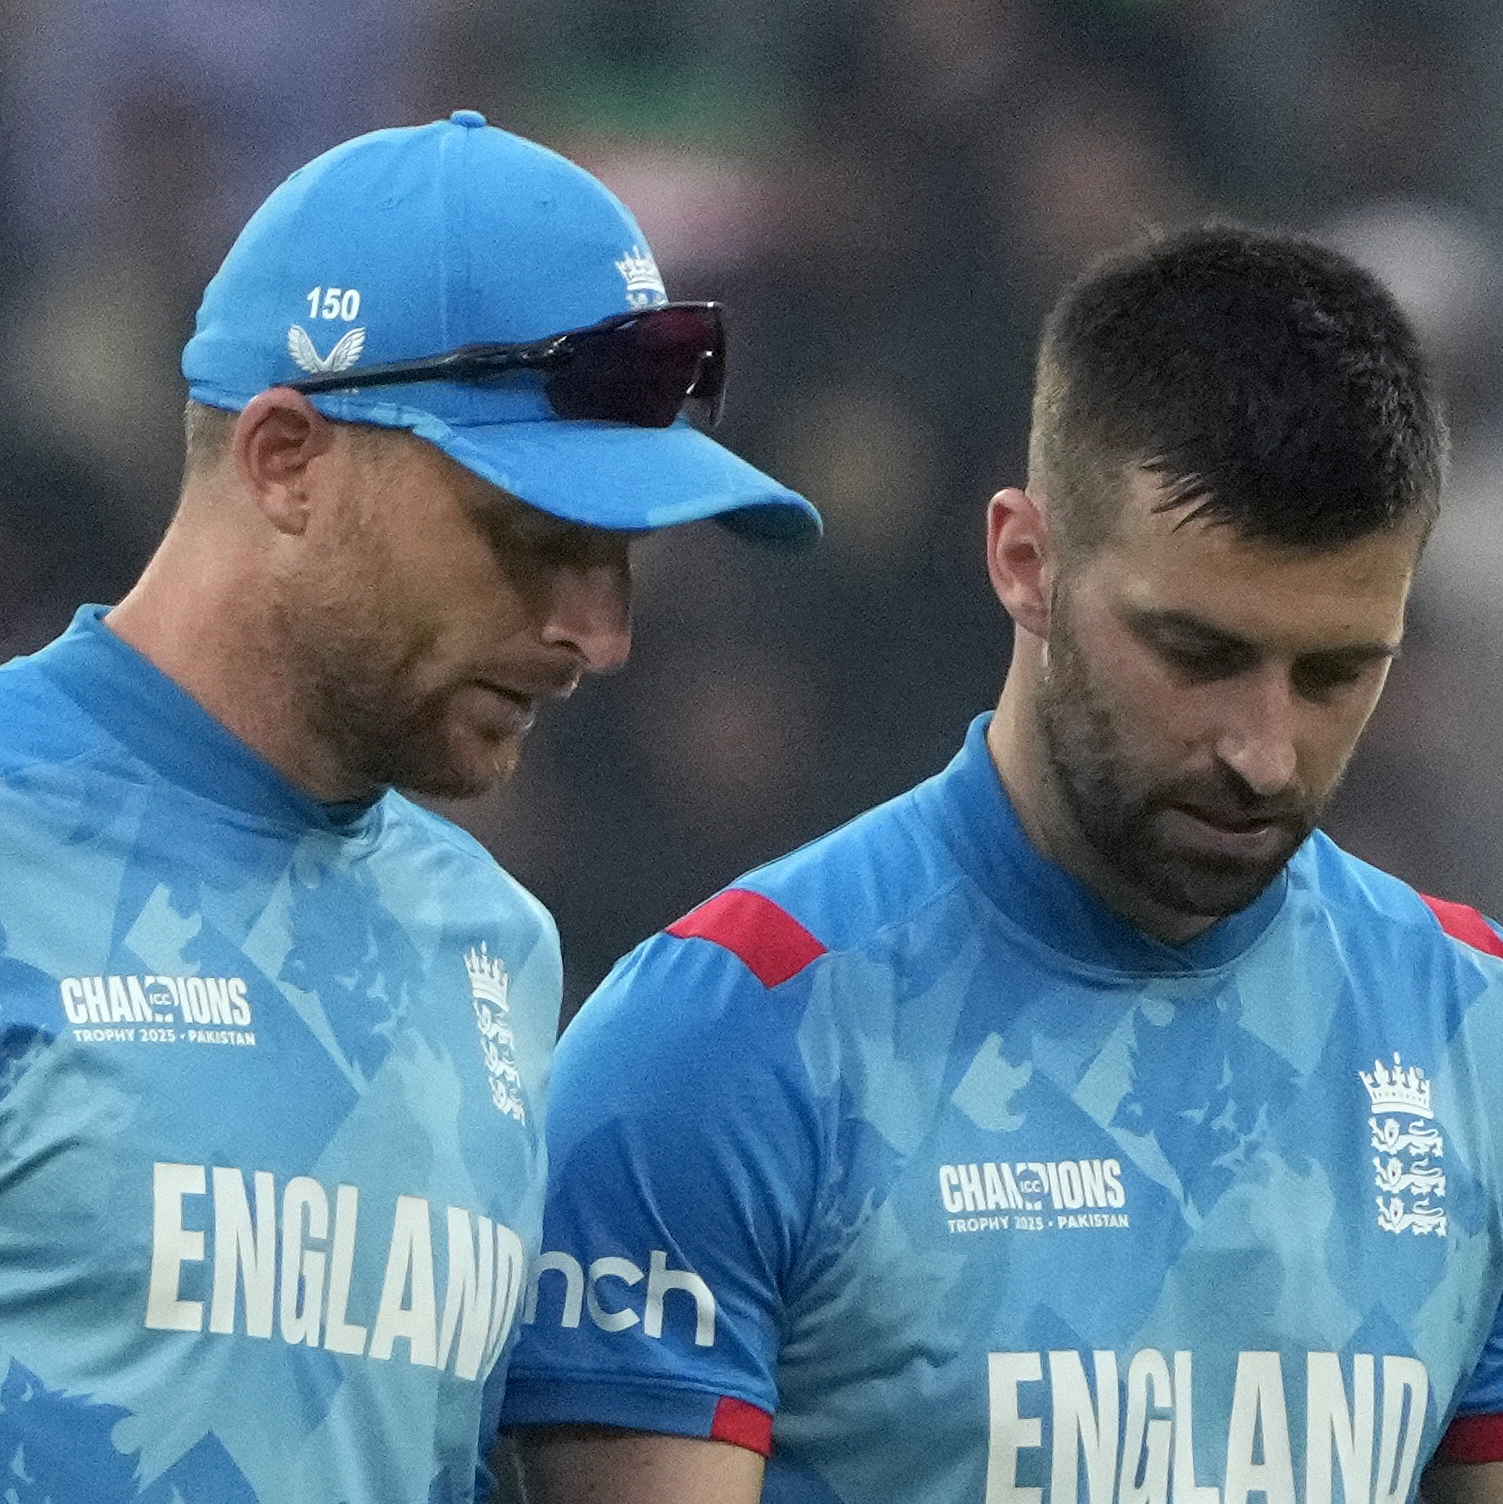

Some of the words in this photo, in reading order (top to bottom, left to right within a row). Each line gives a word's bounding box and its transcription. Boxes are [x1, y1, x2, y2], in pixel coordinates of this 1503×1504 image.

[306, 285, 361, 323] 150
[73, 1029, 135, 1042] TROPHY
[140, 1029, 176, 1042] 2025
[189, 1030, 256, 1046] PAKISTAN
[948, 1216, 1009, 1233] TROPHY
[1014, 1216, 1044, 1230] 2025
[1057, 1214, 1129, 1229] PAKISTAN
[143, 1161, 524, 1382] ENGLAND
[524, 1249, 717, 1347] nch
